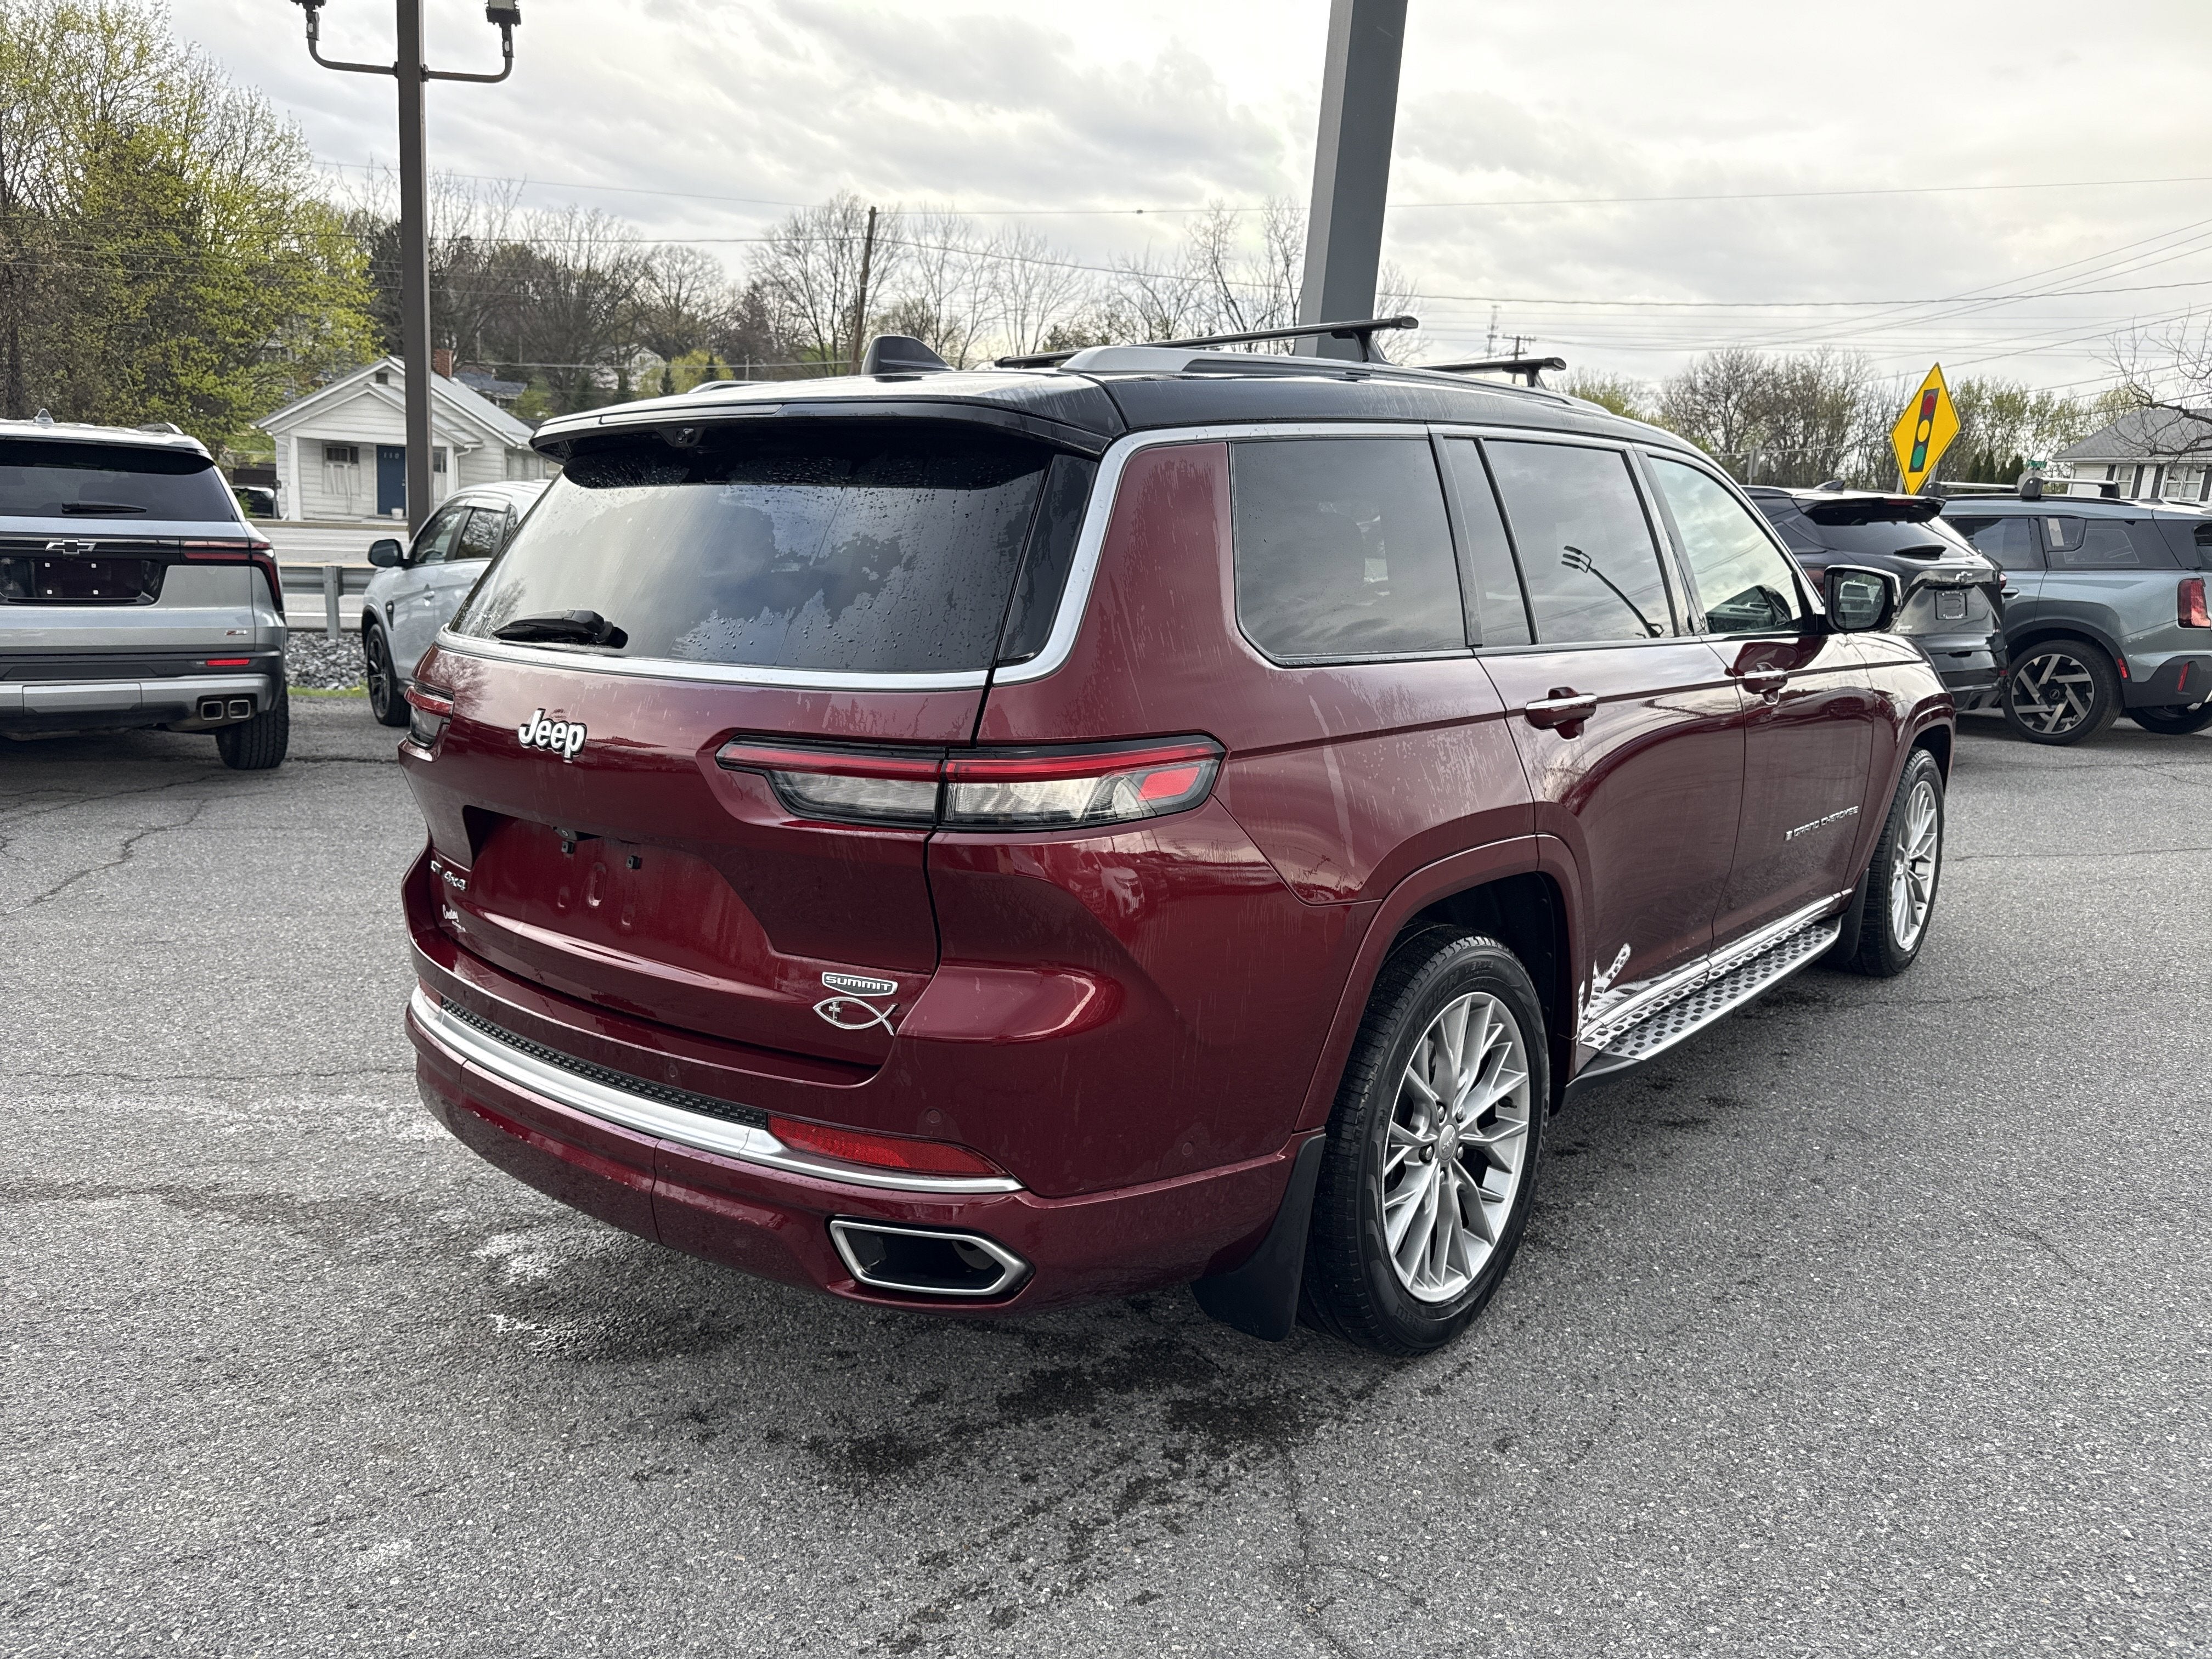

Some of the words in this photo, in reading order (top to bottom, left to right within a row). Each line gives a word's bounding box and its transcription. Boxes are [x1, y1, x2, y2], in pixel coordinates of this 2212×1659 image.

[518, 708, 587, 761] Jeep
[443, 871, 466, 891] 4x4
[825, 975, 891, 991] SUMMIT
